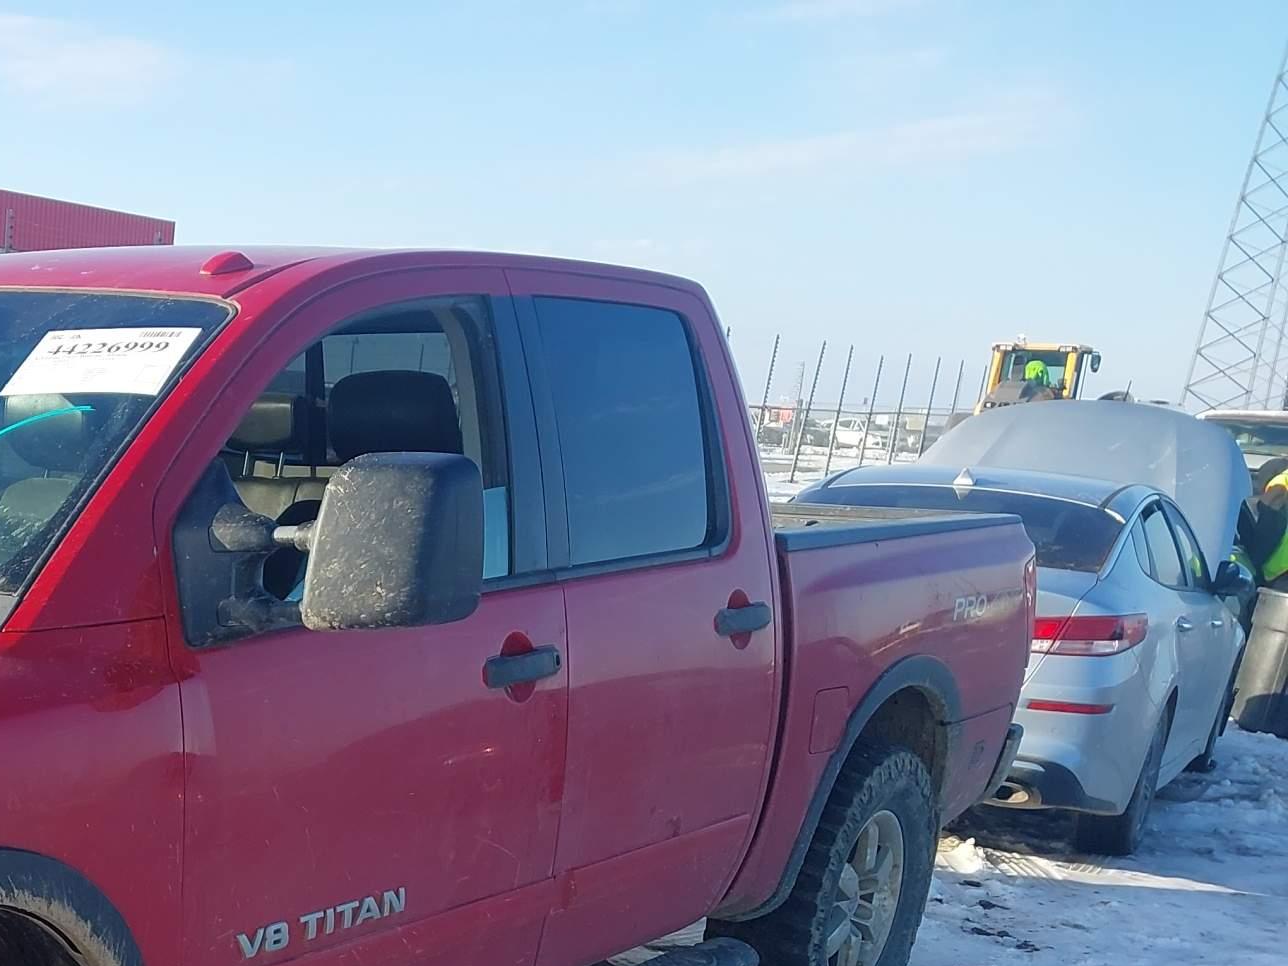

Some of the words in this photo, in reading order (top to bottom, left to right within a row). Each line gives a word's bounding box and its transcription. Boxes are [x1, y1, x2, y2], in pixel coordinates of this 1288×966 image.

[47, 341, 170, 356] 44226999
[236, 922, 289, 960] V8
[300, 887, 406, 941] TITAN
